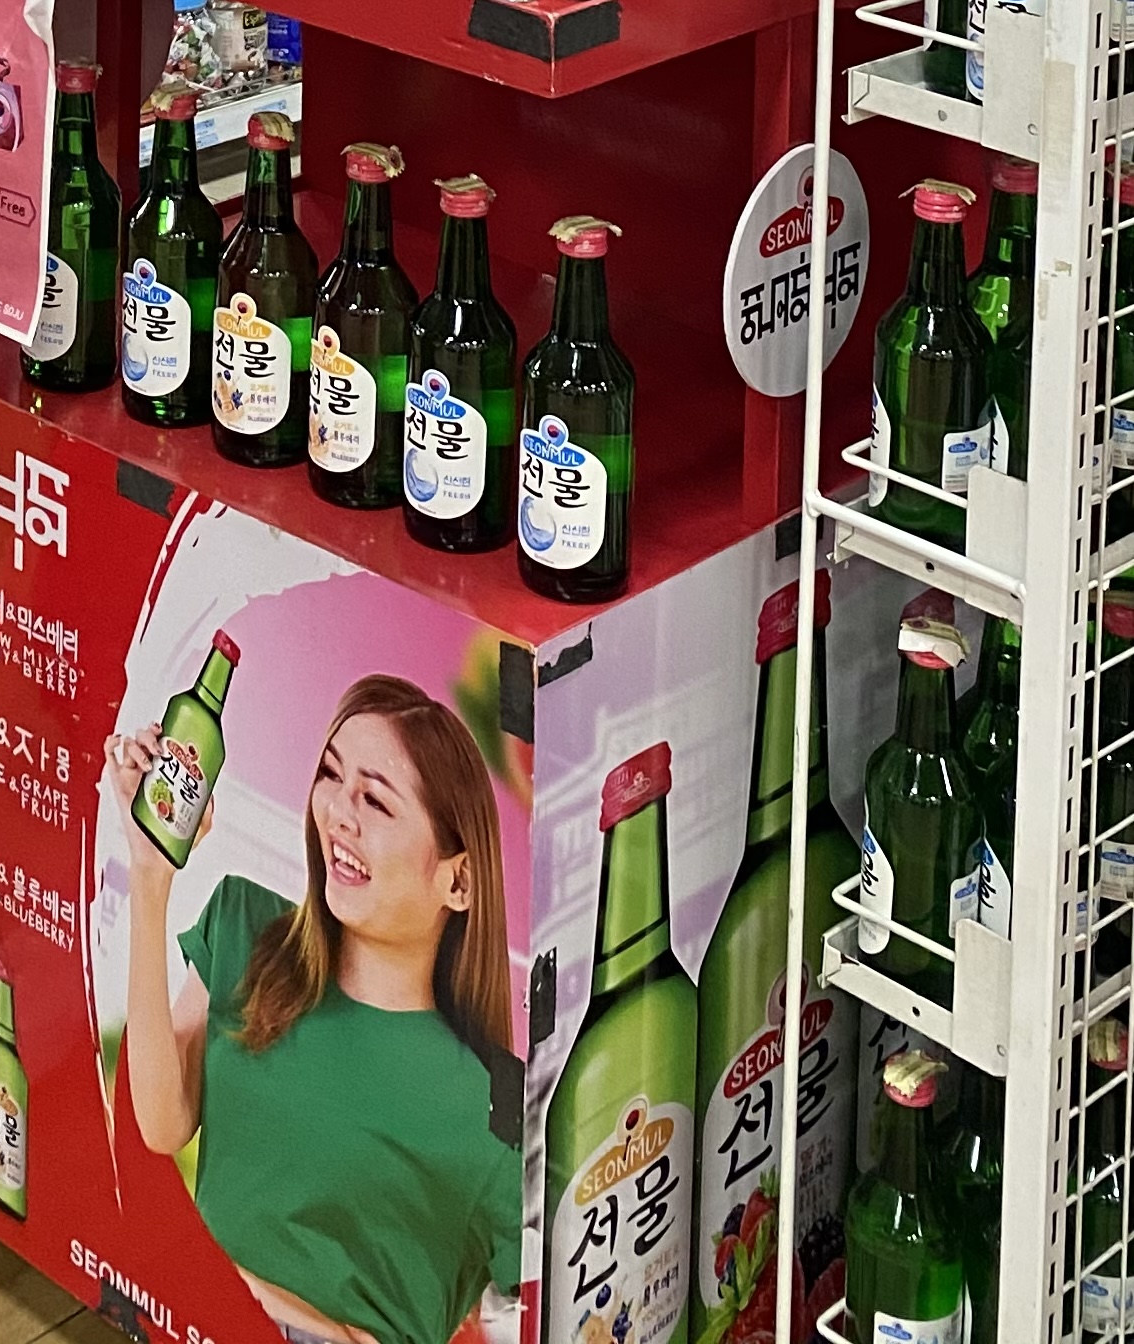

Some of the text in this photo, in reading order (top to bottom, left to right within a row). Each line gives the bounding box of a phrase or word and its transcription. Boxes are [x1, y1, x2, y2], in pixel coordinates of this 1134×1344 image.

[0, 195, 26, 217] Free
[215, 330, 277, 379] 선물
[408, 390, 462, 419] SEONMUL
[406, 406, 471, 460] 선물
[523, 435, 580, 467] SEONMUL
[521, 452, 591, 509] 선물
[23, 645, 78, 684] MIXED
[23, 662, 77, 701] BERRY
[21, 773, 70, 812] GRAPE
[21, 791, 69, 832] FRUIT
[731, 1010, 827, 1086] SEONUL
[582, 1125, 667, 1200] SEONMUL
[567, 1154, 680, 1304] 선물
